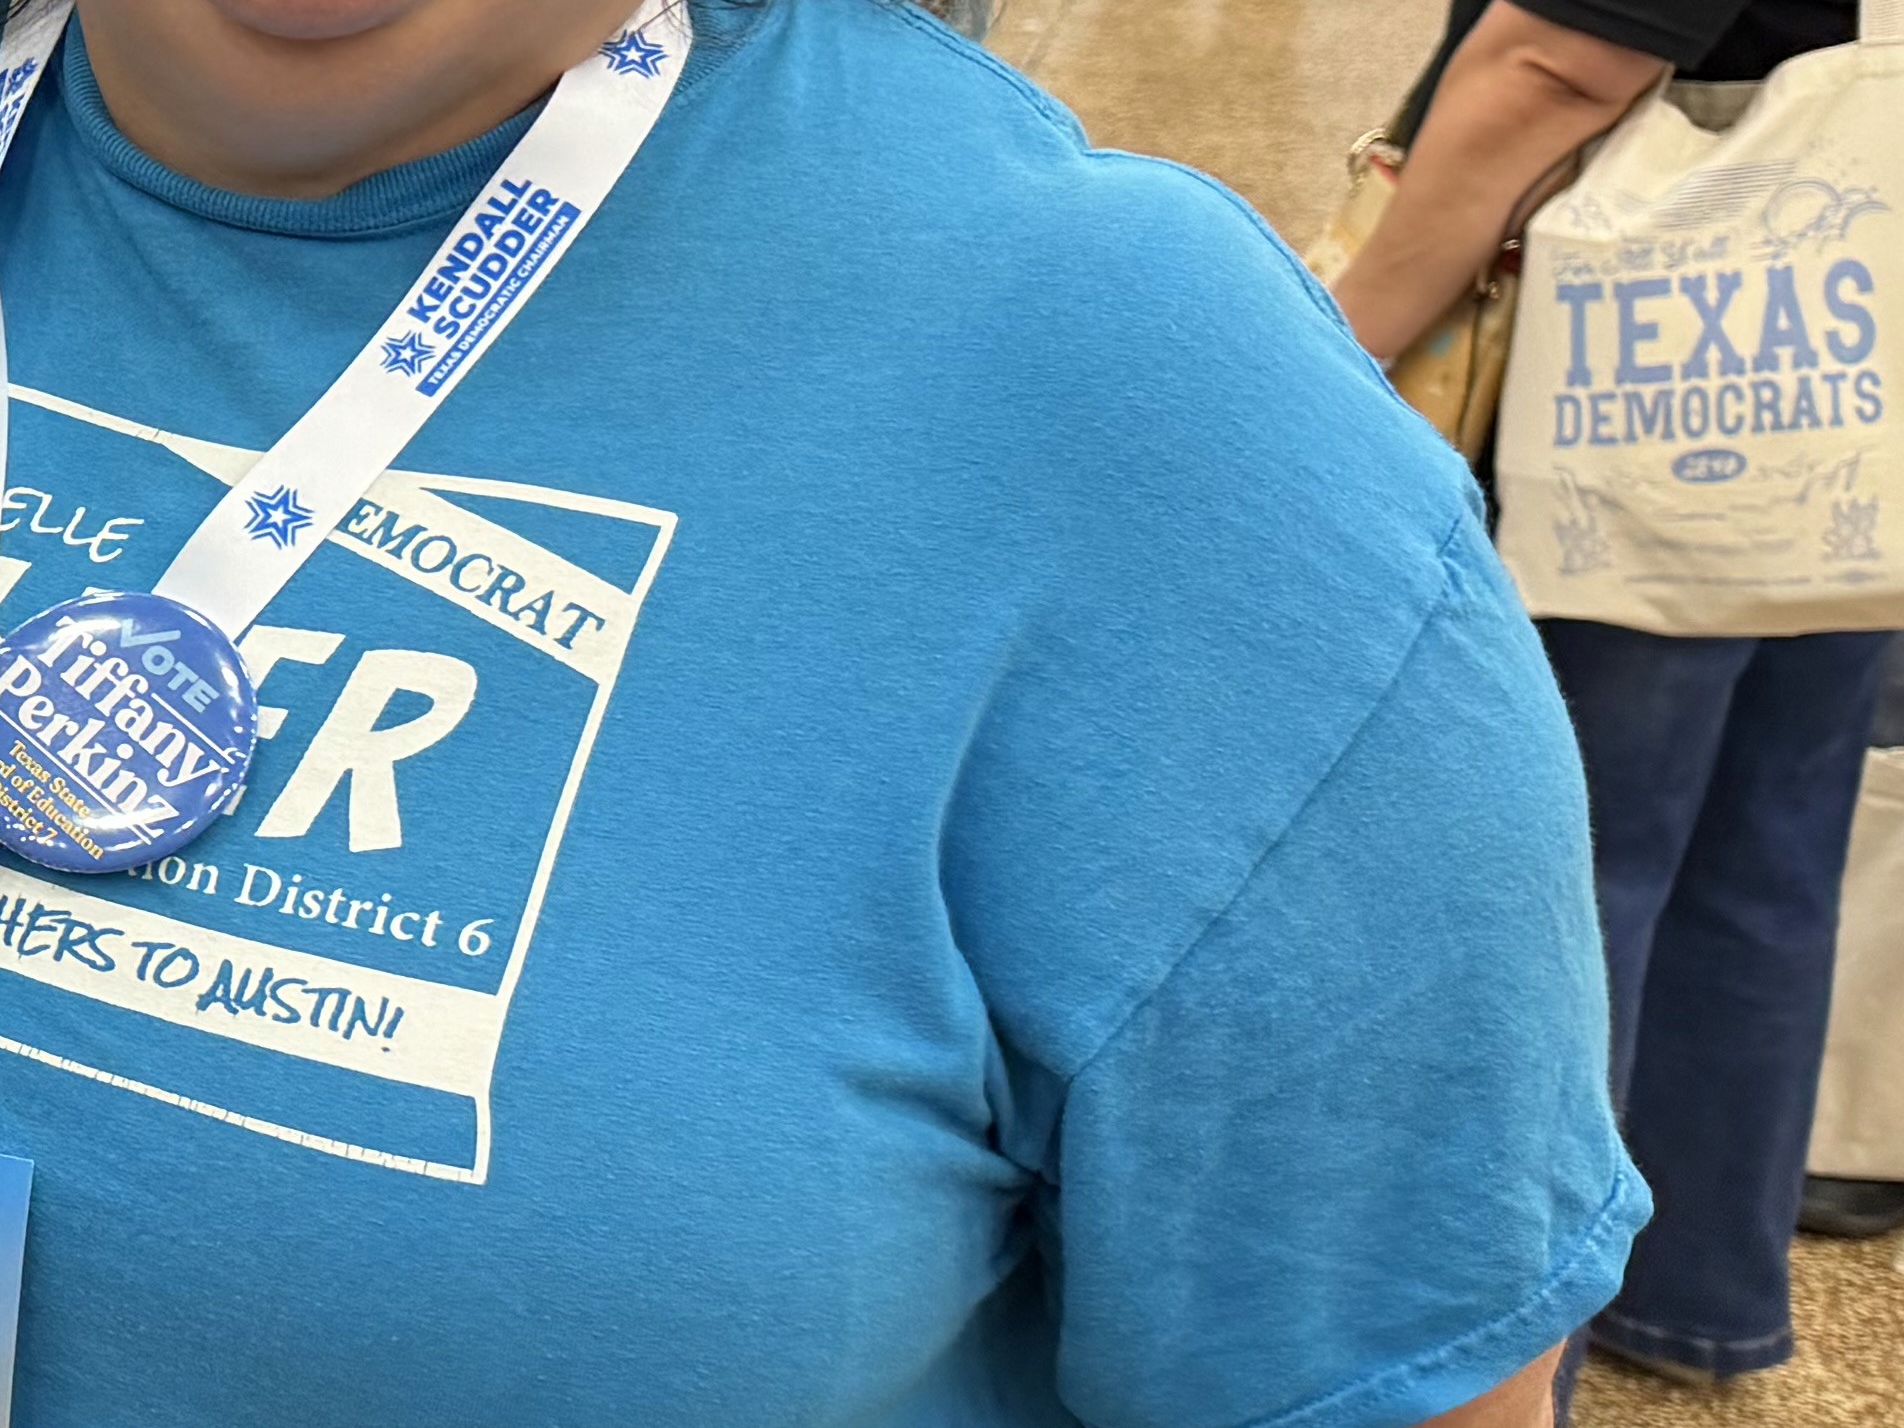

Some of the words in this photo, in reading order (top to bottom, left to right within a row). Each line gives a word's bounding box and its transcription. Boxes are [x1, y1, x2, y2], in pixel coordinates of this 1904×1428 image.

[406, 177, 533, 324] KENDALL
[429, 348, 463, 386] TEXAS
[459, 276, 520, 350] DEMOCRATIC
[518, 213, 570, 278] CHAIRMAN
[433, 187, 560, 341] SCUDDER
[1555, 258, 1878, 388] TEXAS
[1553, 370, 1884, 449] DEMOCRATS
[343, 496, 606, 650] EMOCRAT
[37, 616, 223, 787] Tiffany
[120, 618, 220, 714] VOTE
[9, 739, 51, 784] Texas
[50, 772, 92, 820] State
[12, 772, 33, 795] of
[26, 787, 104, 860] Education
[234, 863, 443, 947] District
[458, 918, 495, 956] 6
[132, 940, 199, 990] TO
[197, 958, 406, 1054] AUSTIN!
